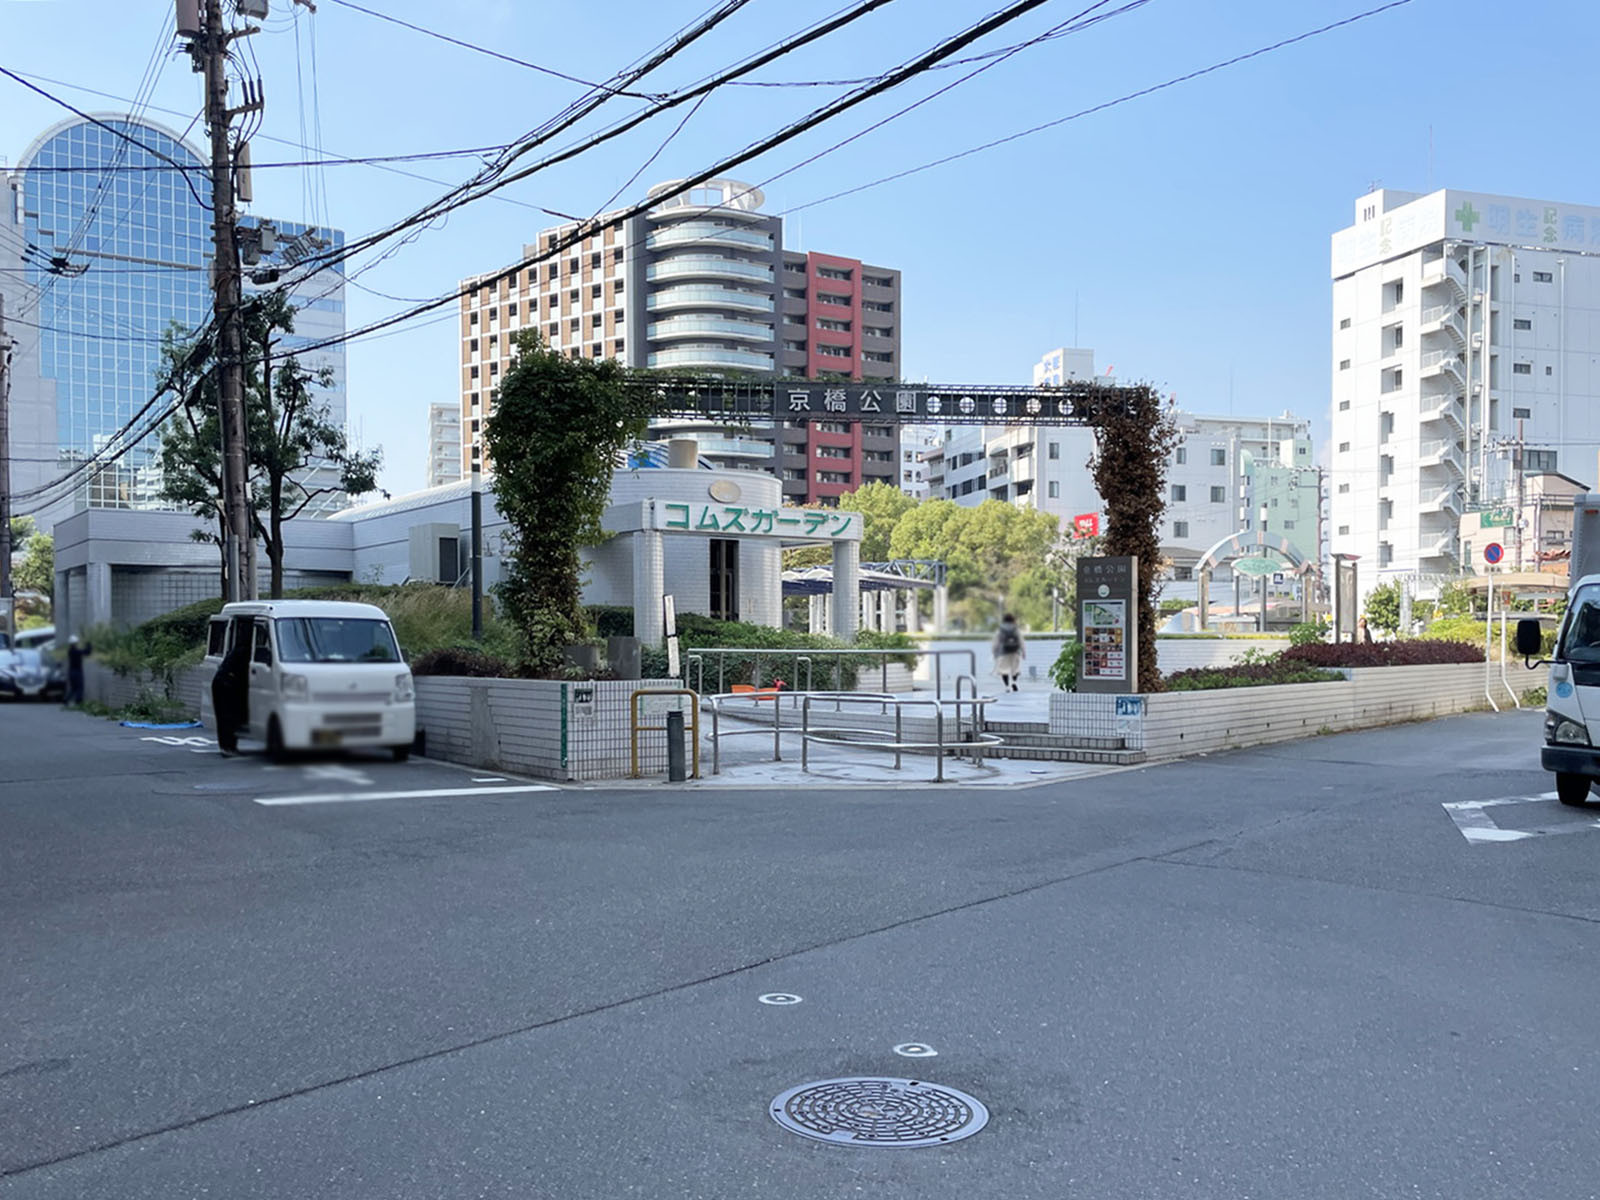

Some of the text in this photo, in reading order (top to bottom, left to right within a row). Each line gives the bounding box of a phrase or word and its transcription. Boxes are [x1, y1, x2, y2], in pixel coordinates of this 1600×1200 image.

[665, 503, 852, 537] コムズガーデン
